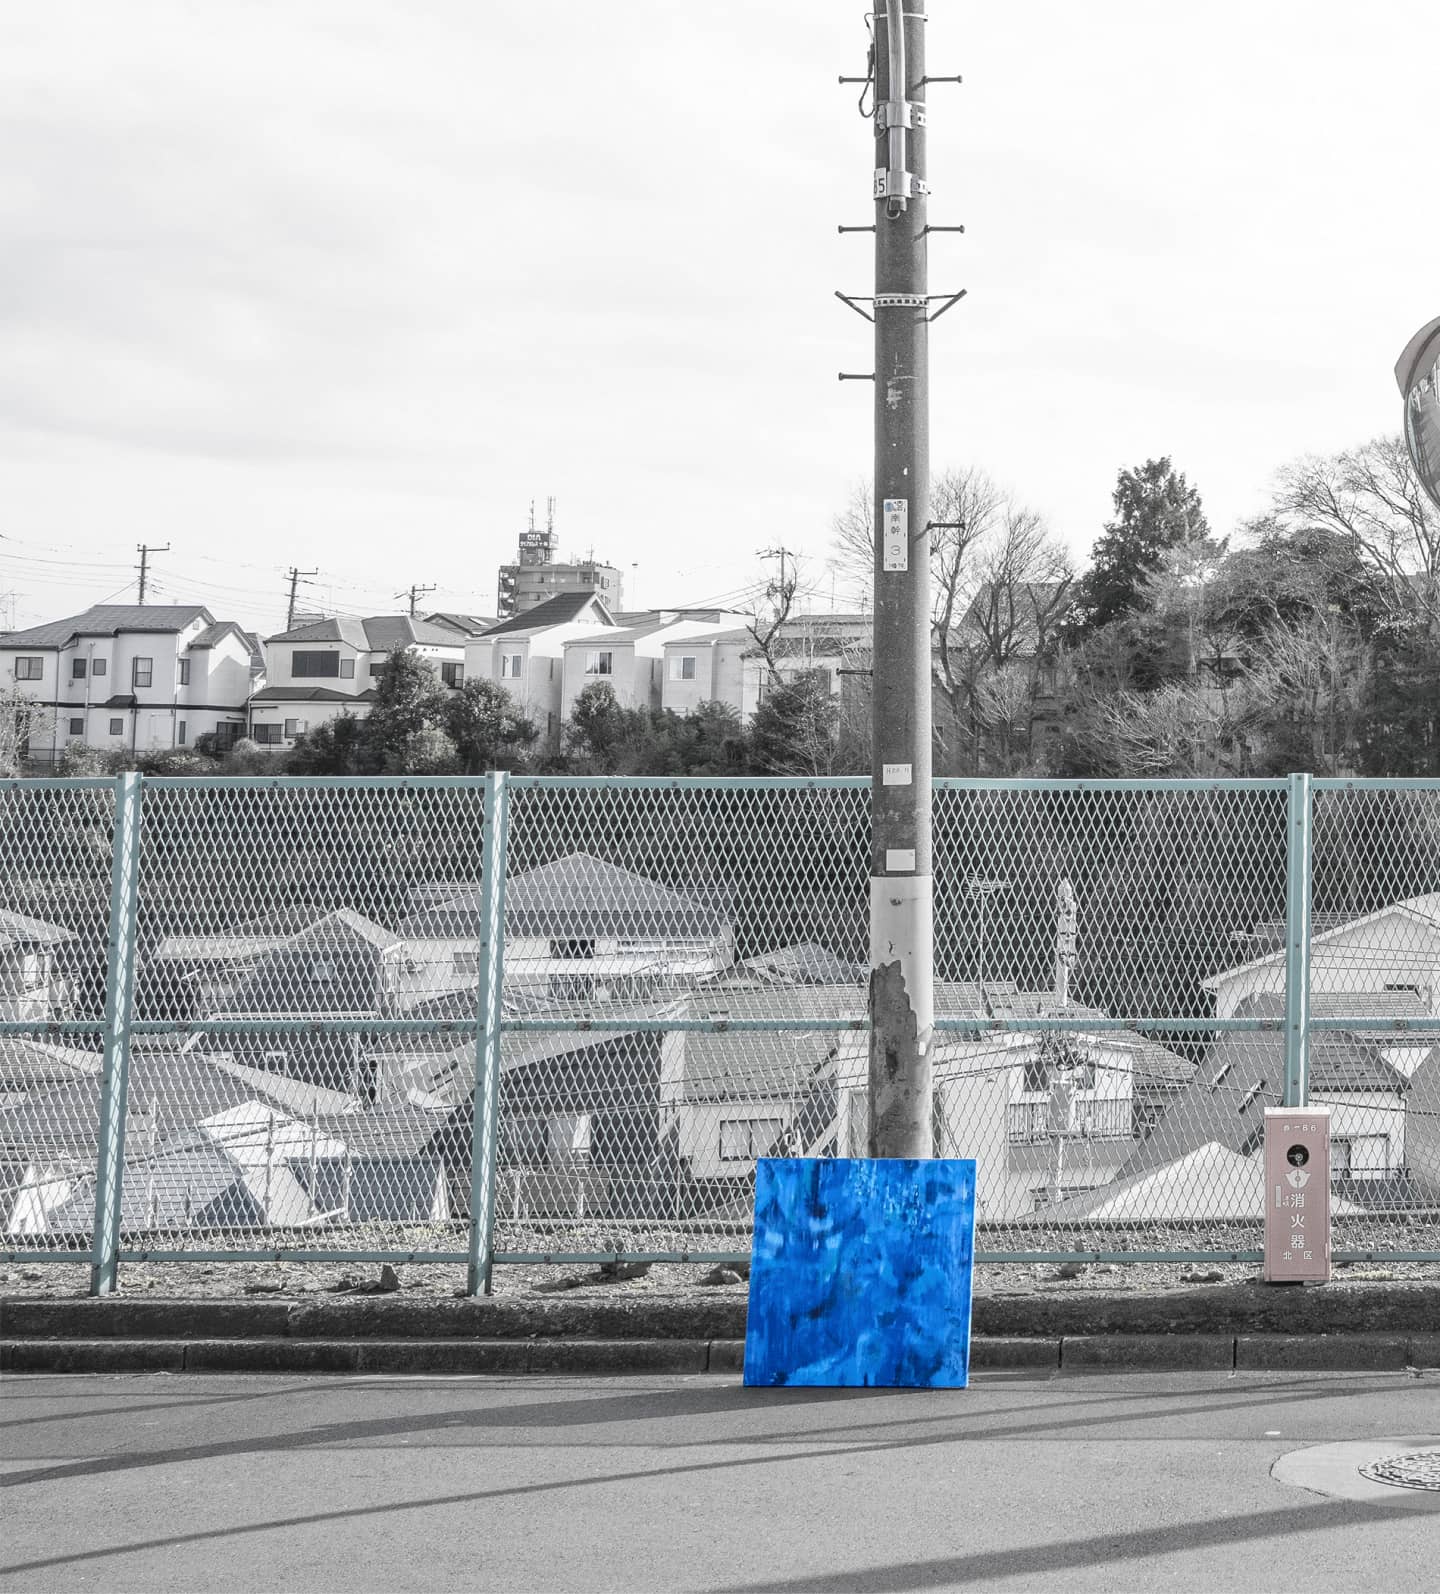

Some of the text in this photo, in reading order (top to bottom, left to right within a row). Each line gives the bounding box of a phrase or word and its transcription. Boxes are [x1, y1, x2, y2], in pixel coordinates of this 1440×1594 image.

[1290, 1193, 1305, 1249] 消火器
[1283, 1251, 1313, 1261] 北区
